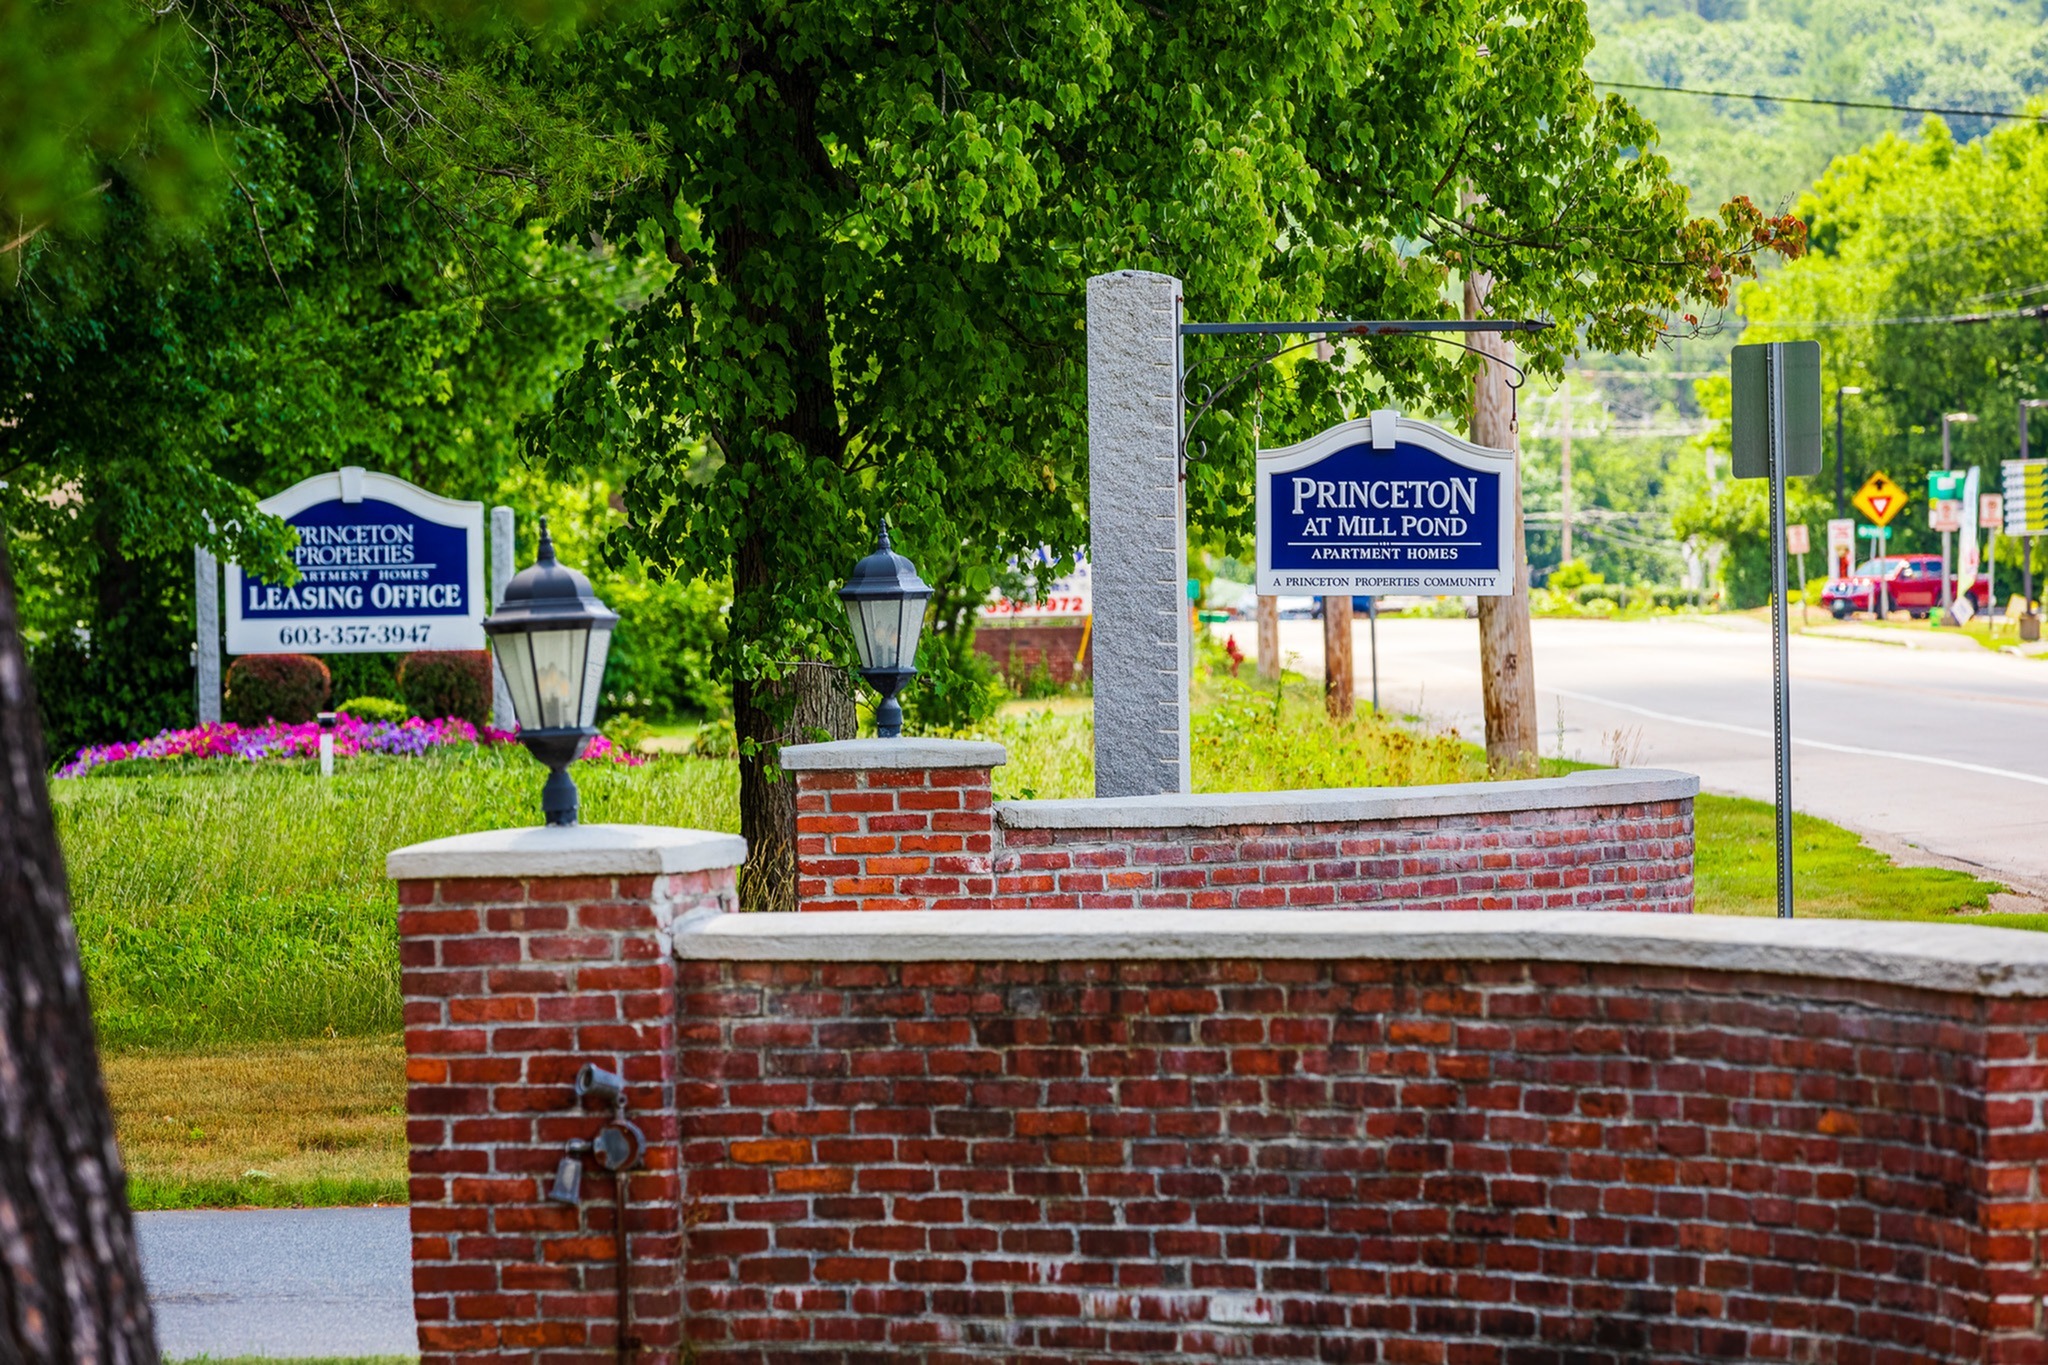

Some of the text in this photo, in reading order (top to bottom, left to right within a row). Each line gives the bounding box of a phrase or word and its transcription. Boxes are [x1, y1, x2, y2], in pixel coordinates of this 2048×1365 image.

[1292, 477, 1477, 514] PRINCETON
[295, 524, 414, 545] PRINCETON
[1302, 515, 1468, 537] AT MILL POND
[295, 544, 415, 565] PROPERTIES
[1311, 548, 1458, 560] APARTMENT HOMES
[301, 569, 430, 582] ARTMENT HOMES
[1273, 577, 1496, 588] A PRINCETON PROPERTIES COMMUNITY
[249, 583, 462, 611] LEASING OFFICE
[279, 624, 431, 646] 603-357-3947
